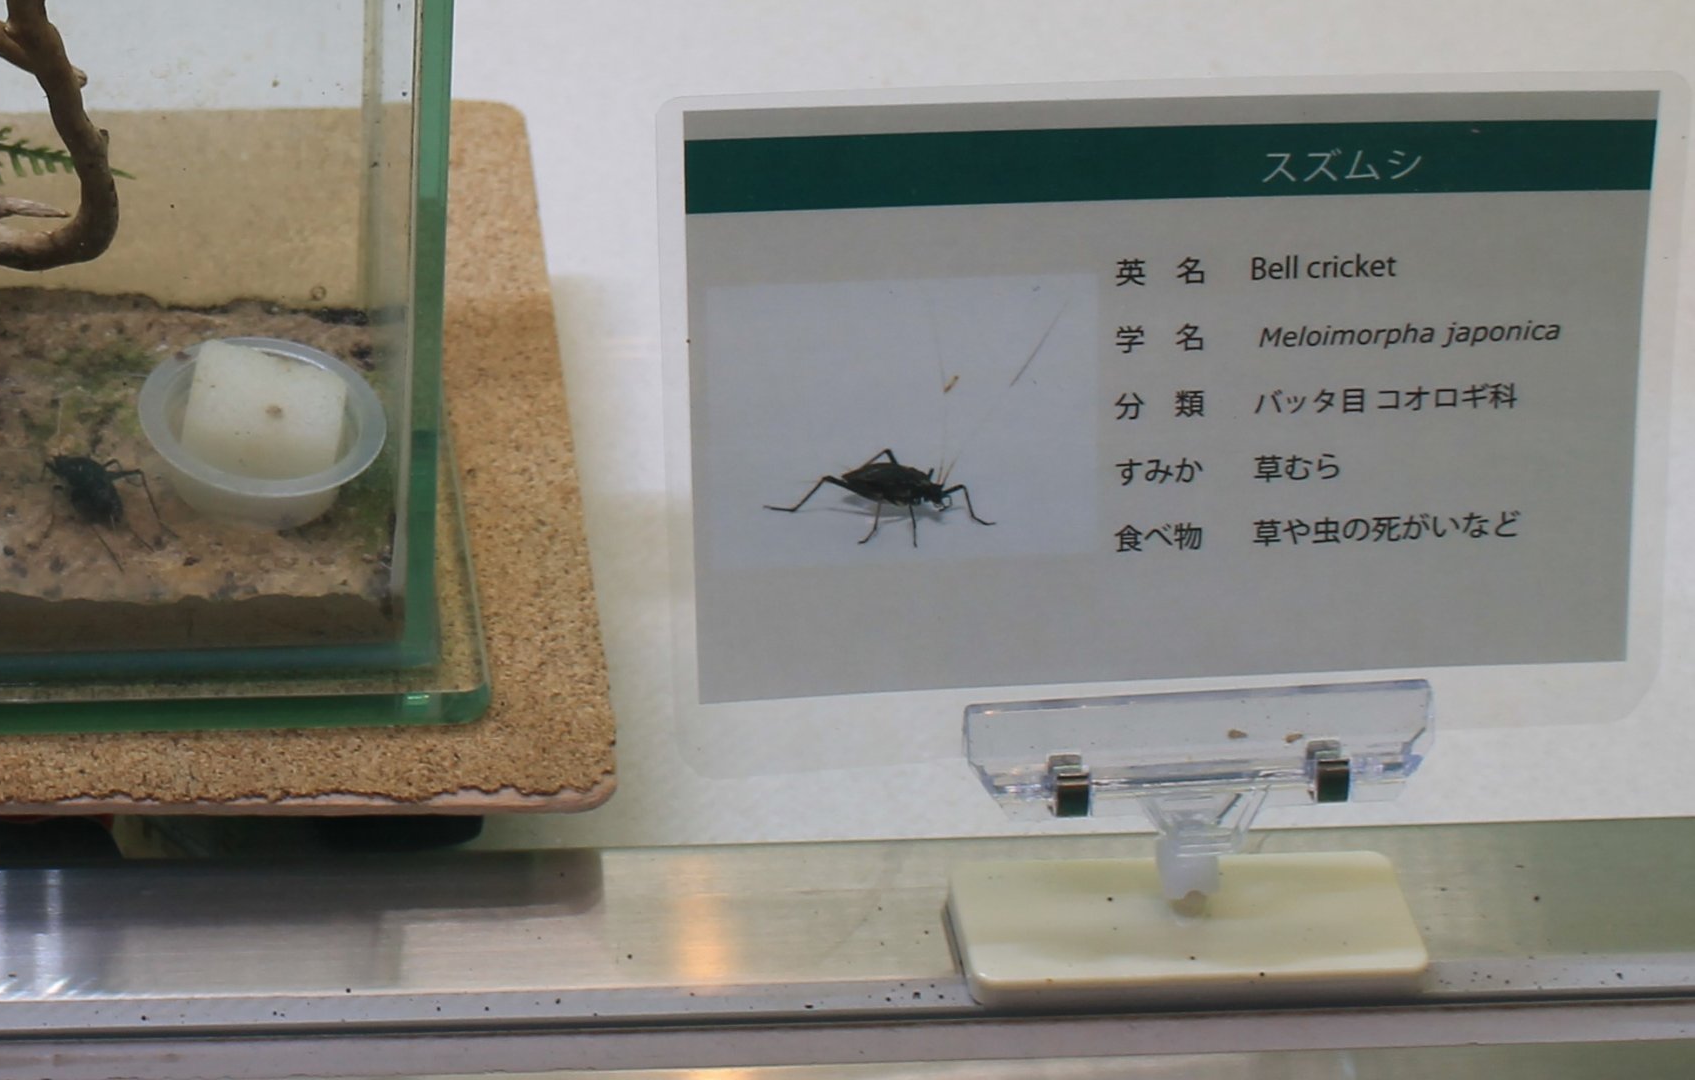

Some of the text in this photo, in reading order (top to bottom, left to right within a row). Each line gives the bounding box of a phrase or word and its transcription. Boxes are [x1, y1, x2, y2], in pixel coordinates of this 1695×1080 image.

[1260, 149, 1424, 185] スズムシ
[1250, 253, 1398, 281] Bell cricket
[1258, 320, 1561, 350] Meloimorpha japonica
[1253, 382, 1518, 416] バッタ目 コオロギ科
[1115, 457, 1204, 486] すみか
[1253, 453, 1341, 482] 草むら
[1114, 523, 1203, 553] 食べ物
[1252, 510, 1522, 547] 草や虫の死がいなど
